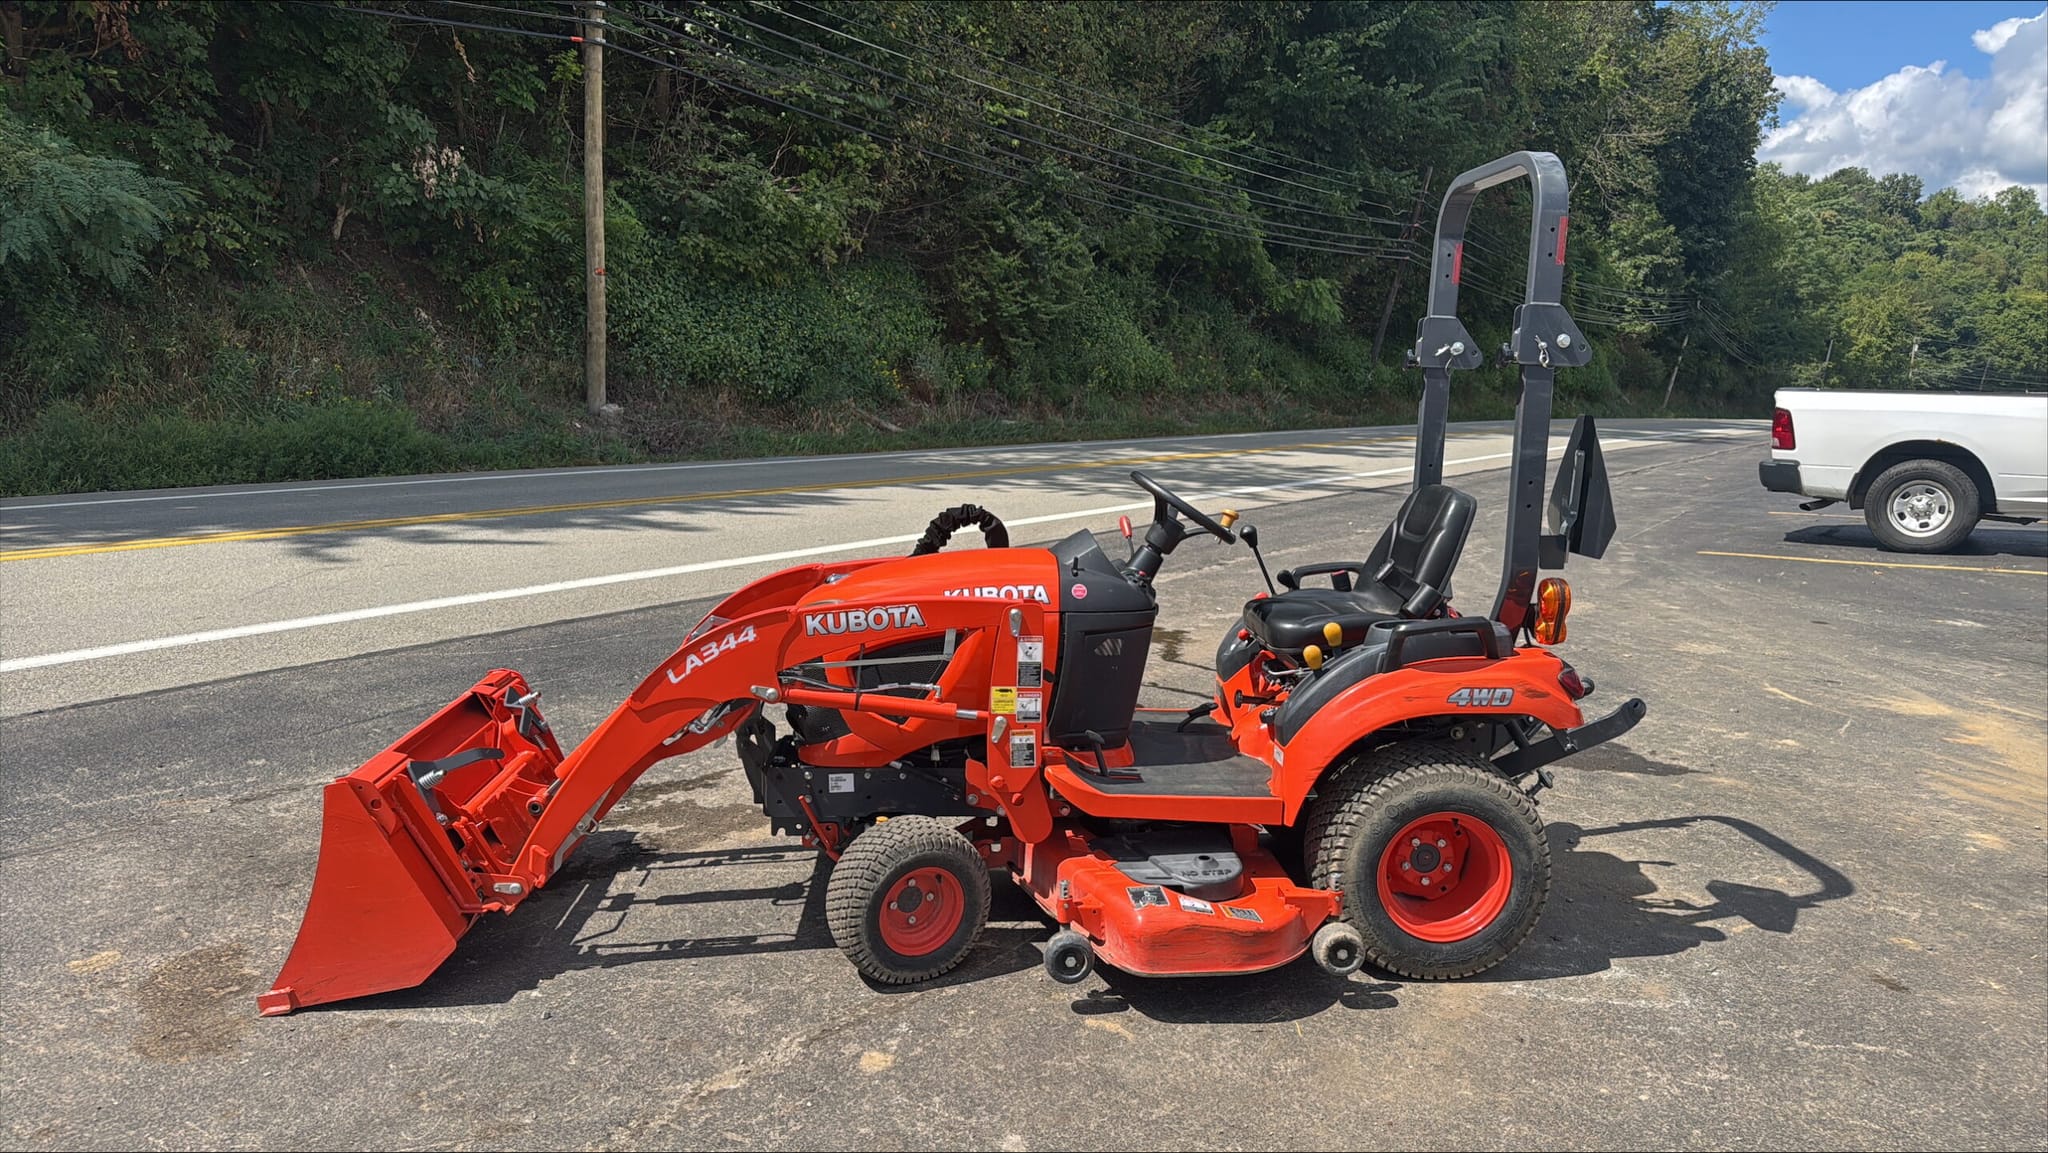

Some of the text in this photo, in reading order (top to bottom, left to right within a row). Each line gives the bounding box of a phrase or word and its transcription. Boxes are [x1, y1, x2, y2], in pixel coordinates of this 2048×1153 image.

[805, 604, 927, 636] KUBOTA
[667, 625, 757, 684] LA344
[1447, 687, 1514, 706] 4WD
[1202, 868, 1232, 876] STEP
